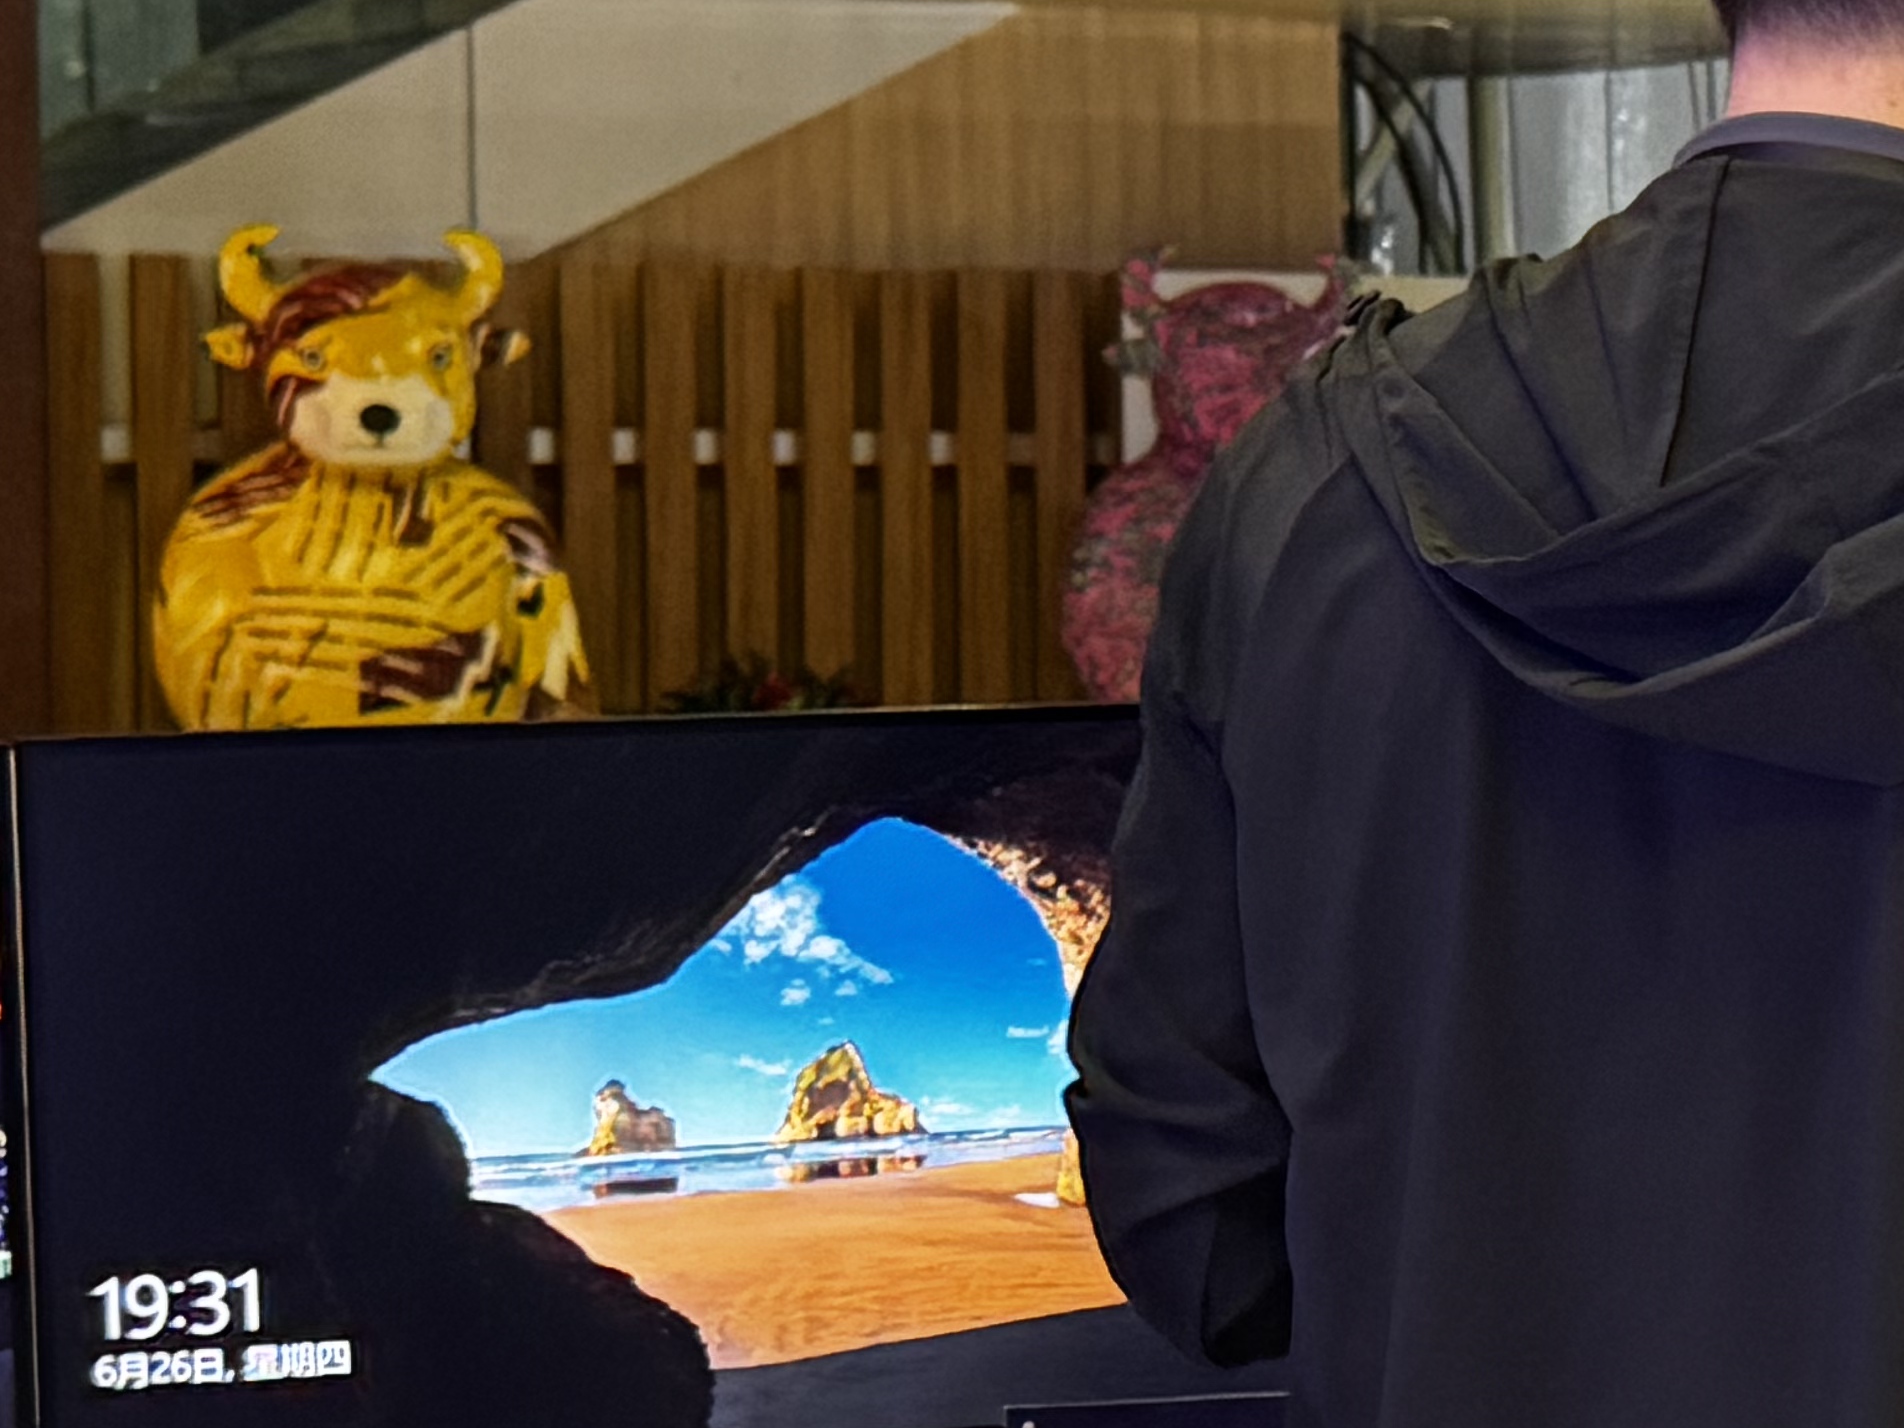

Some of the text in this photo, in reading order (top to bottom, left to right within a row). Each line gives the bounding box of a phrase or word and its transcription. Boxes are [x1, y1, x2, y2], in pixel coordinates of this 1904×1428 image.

[87, 1267, 260, 1341] 19:31
[92, 1340, 352, 1390] 6月26日, 星期四
